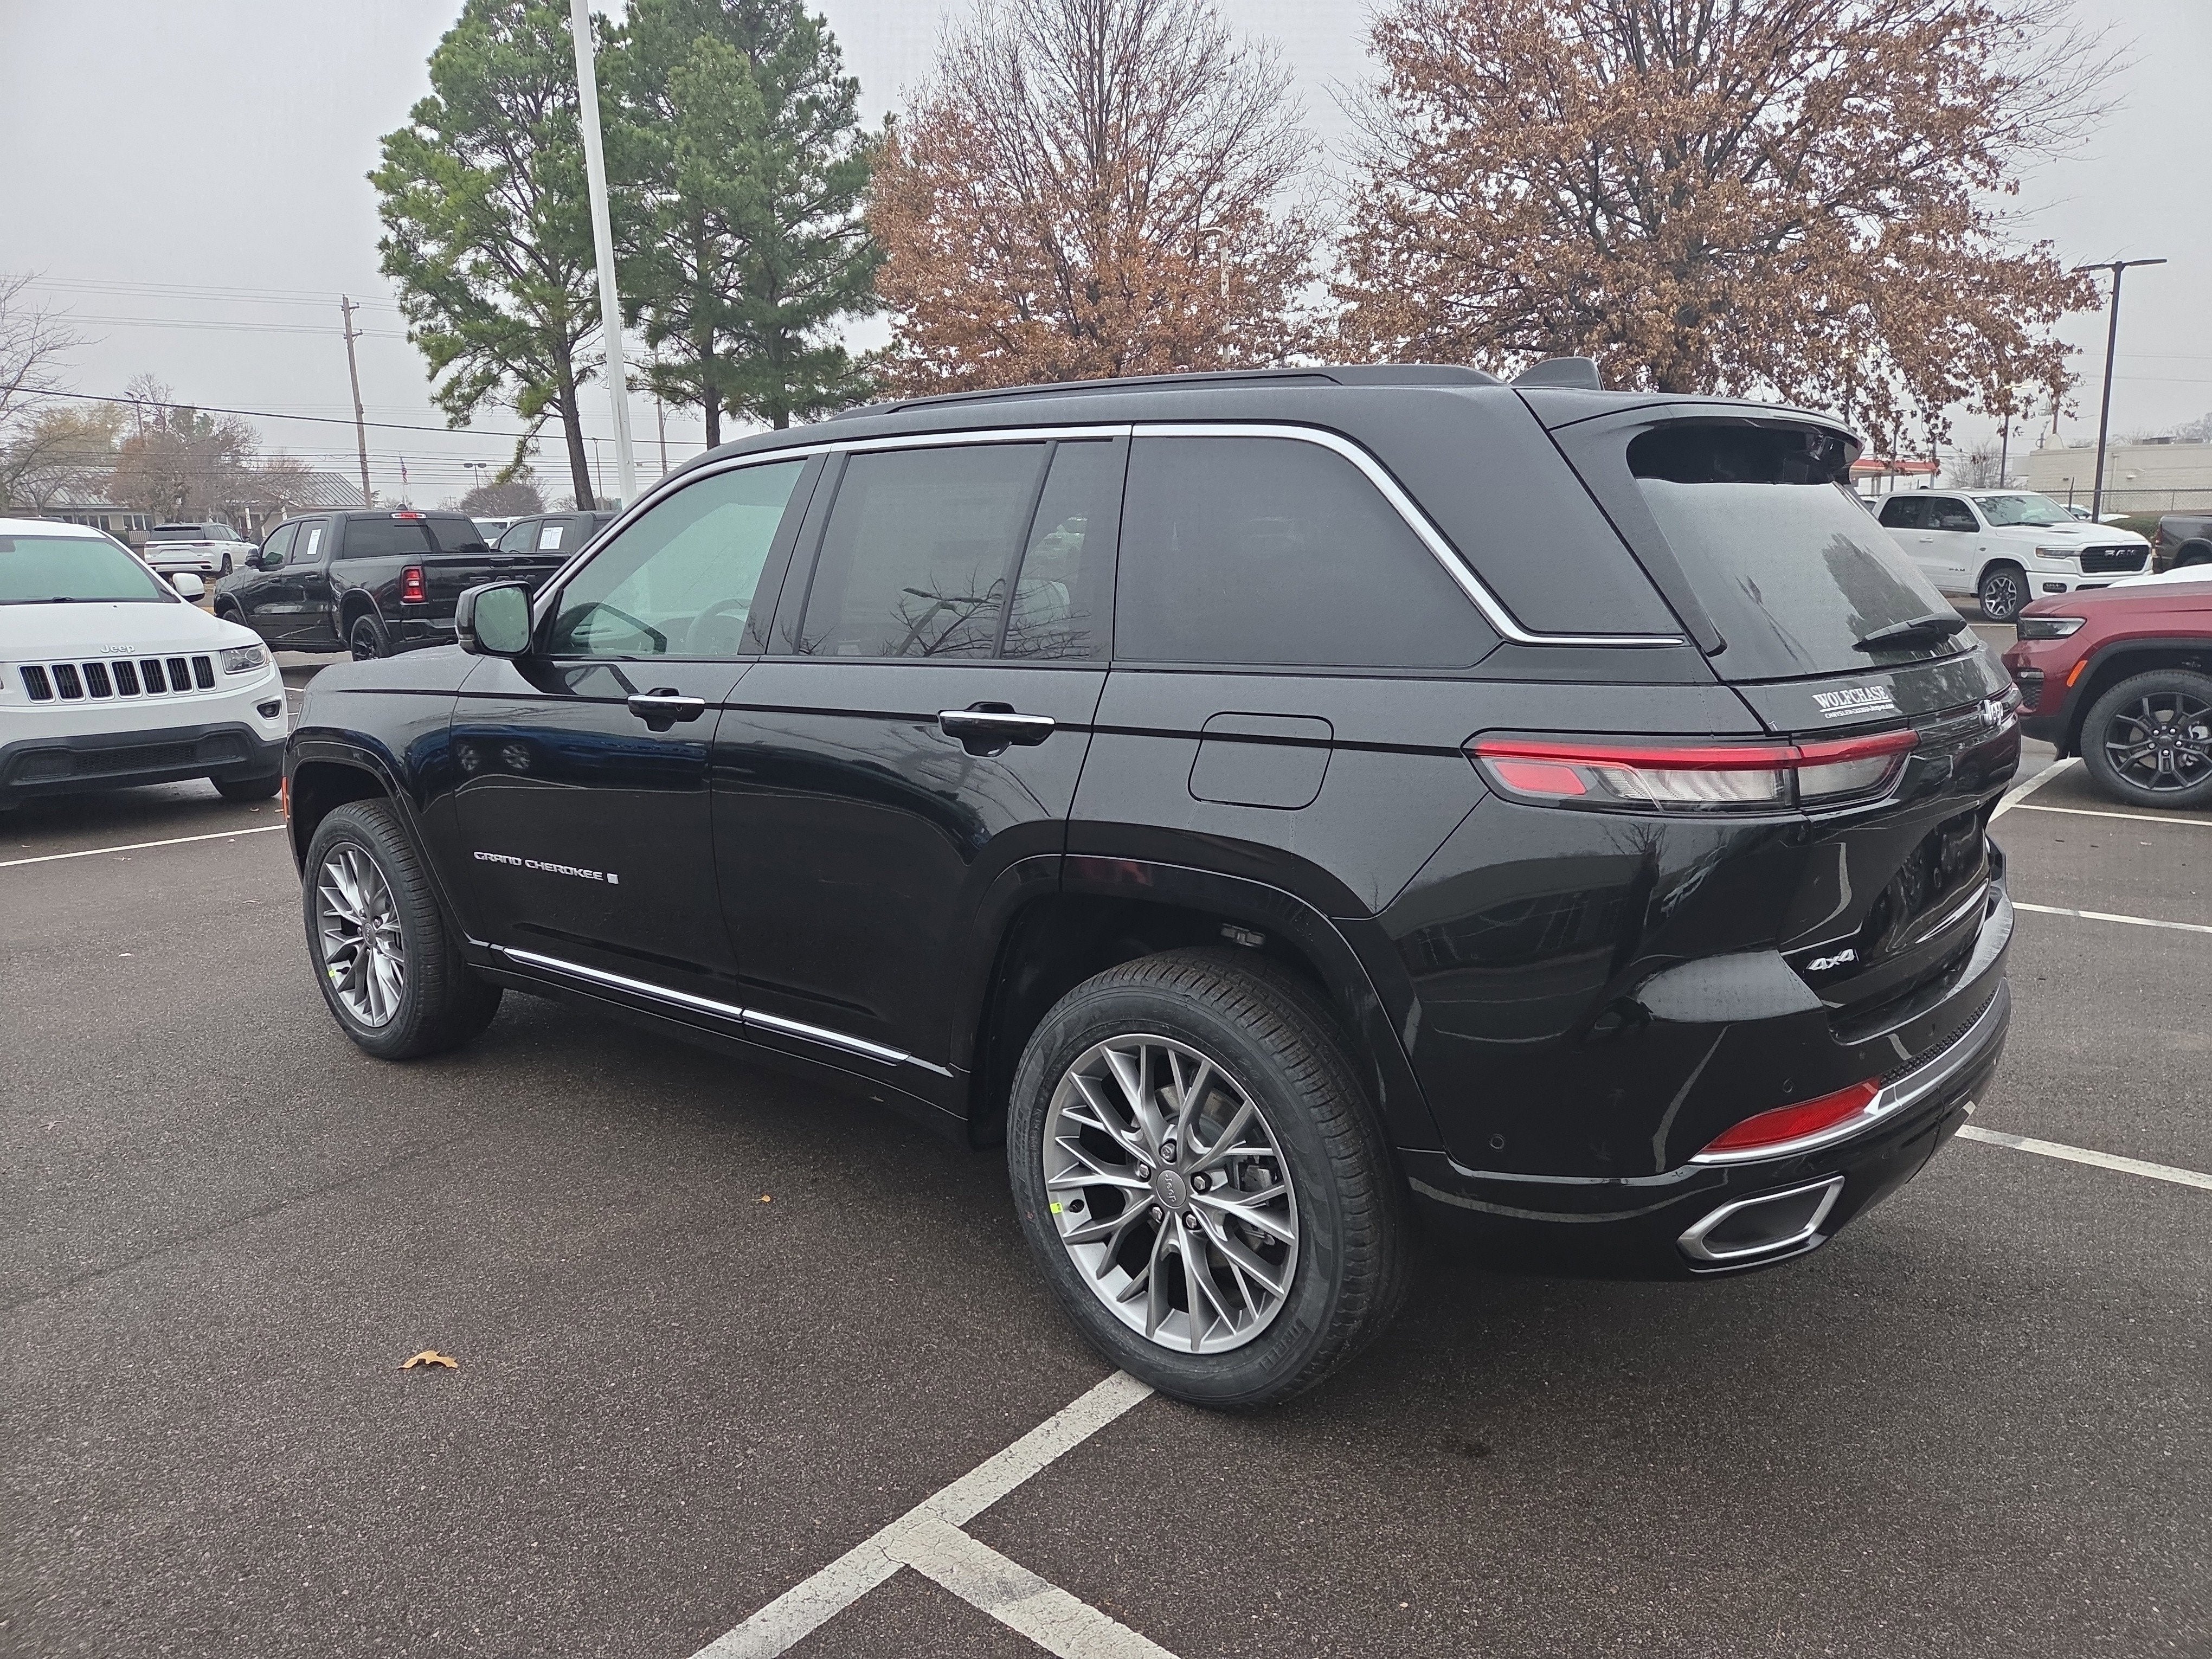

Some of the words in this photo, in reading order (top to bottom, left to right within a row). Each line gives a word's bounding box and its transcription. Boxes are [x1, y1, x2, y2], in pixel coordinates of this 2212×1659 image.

[100, 644, 136, 654] Jeep
[1811, 685, 1889, 709] WOLFCHASE
[1983, 699, 2004, 726] Jeep
[473, 851, 523, 866] GRAND
[524, 859, 605, 881] CHEROKEE
[1806, 948, 1856, 970] 4x4
[1164, 1173, 1178, 1203] Jeep
